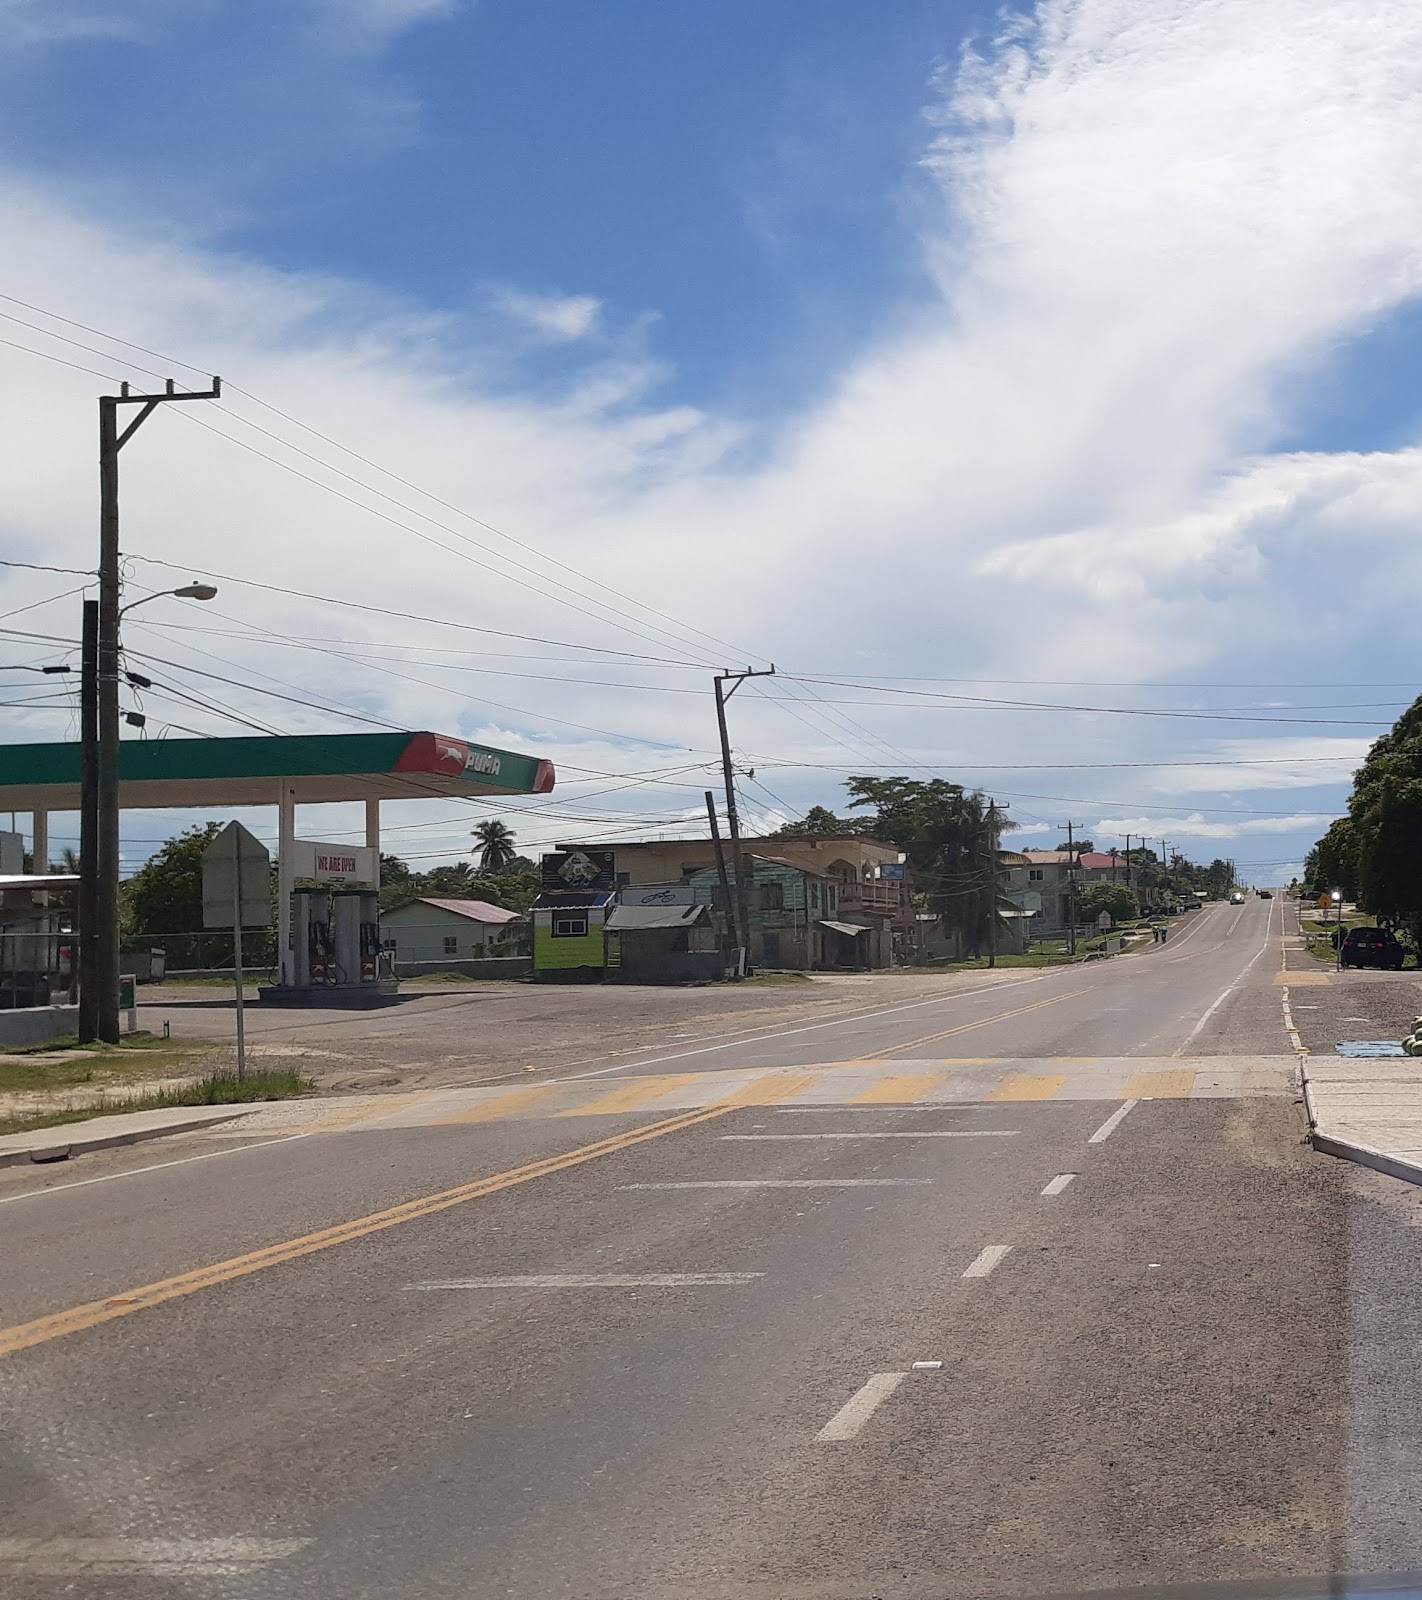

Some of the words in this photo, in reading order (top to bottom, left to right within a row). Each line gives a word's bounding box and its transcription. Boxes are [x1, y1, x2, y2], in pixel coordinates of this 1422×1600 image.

[465, 751, 500, 775] PUMA
[317, 855, 328, 871] WE
[329, 856, 341, 872] ARE
[341, 857, 356, 873] OPEN
